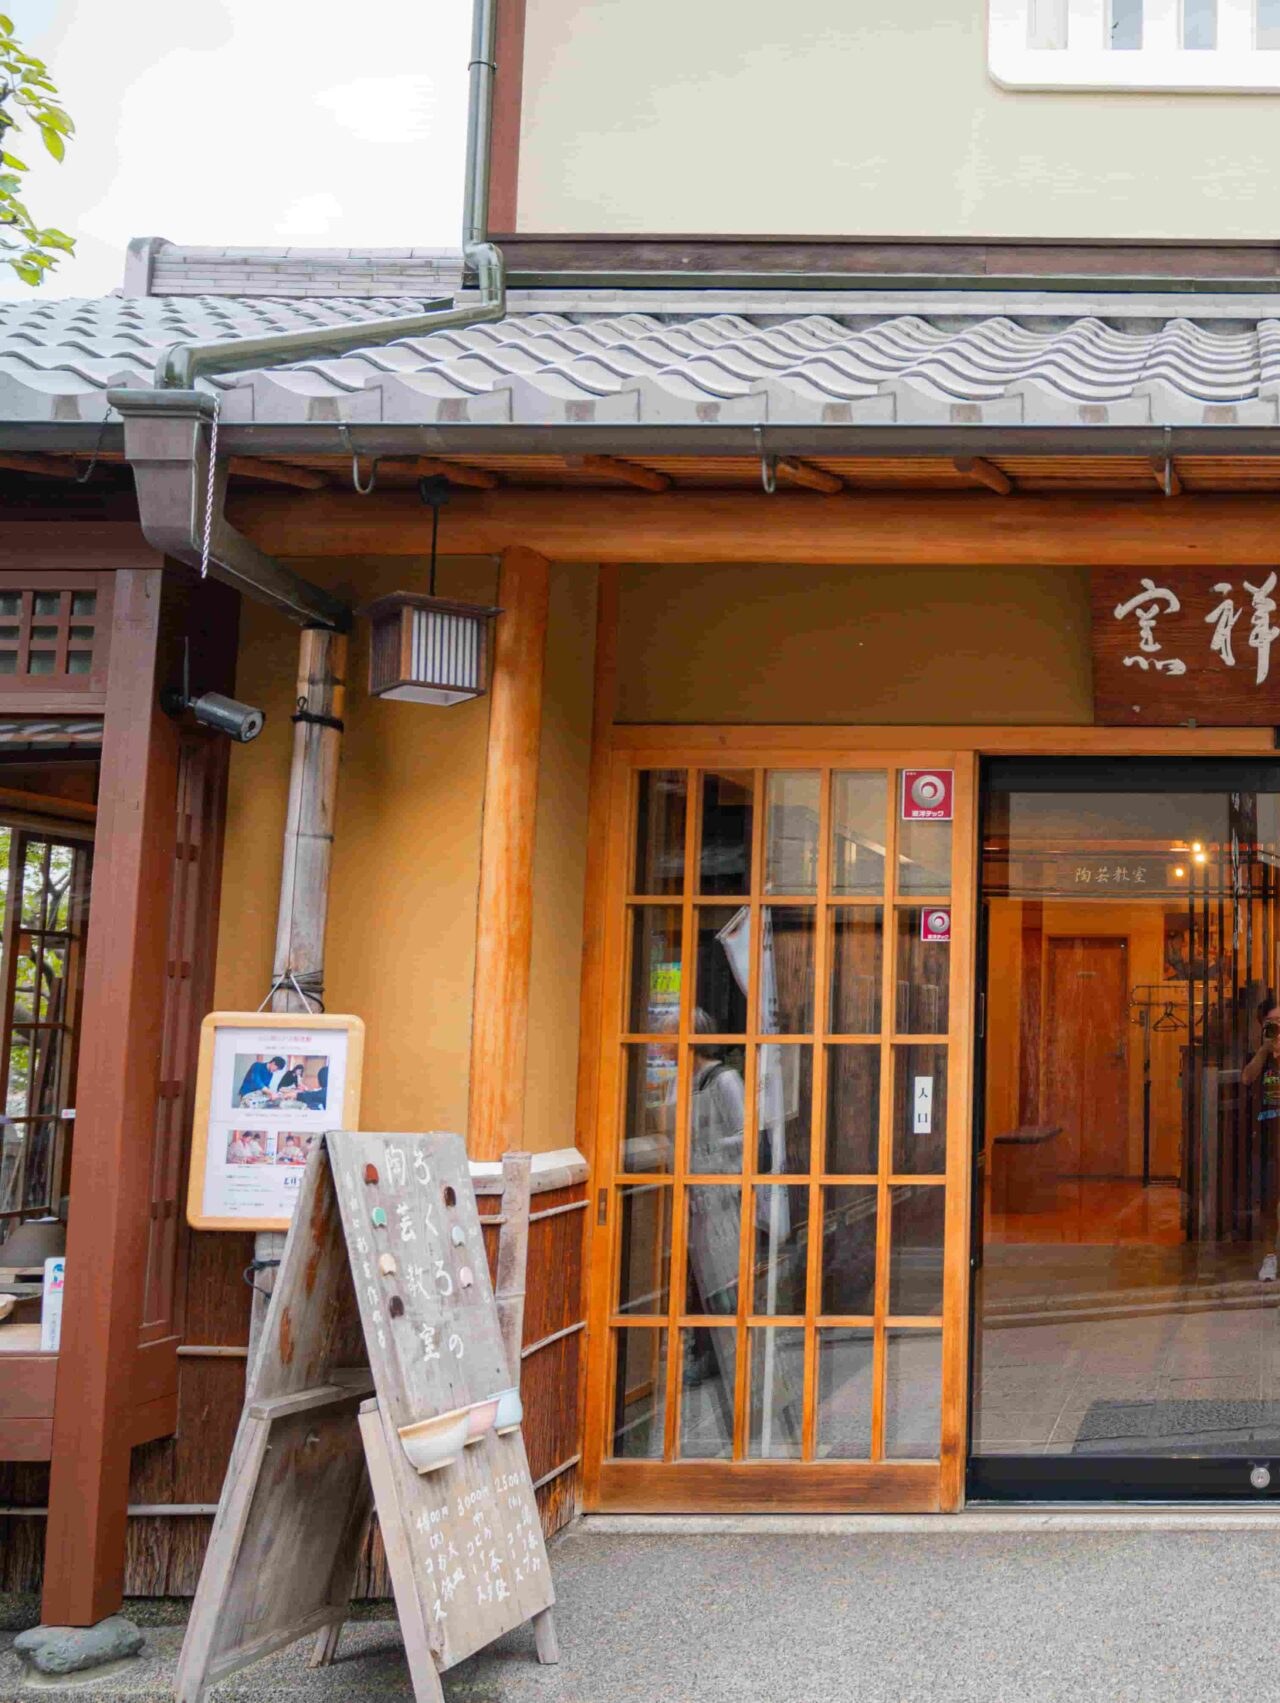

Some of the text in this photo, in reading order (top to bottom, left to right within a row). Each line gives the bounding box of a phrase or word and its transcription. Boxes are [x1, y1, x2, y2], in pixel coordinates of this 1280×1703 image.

[1074, 865, 1148, 884] 陶芸教室
[385, 1144, 441, 1362] 陶芸教室
[413, 1149, 464, 1359] ろくろの
